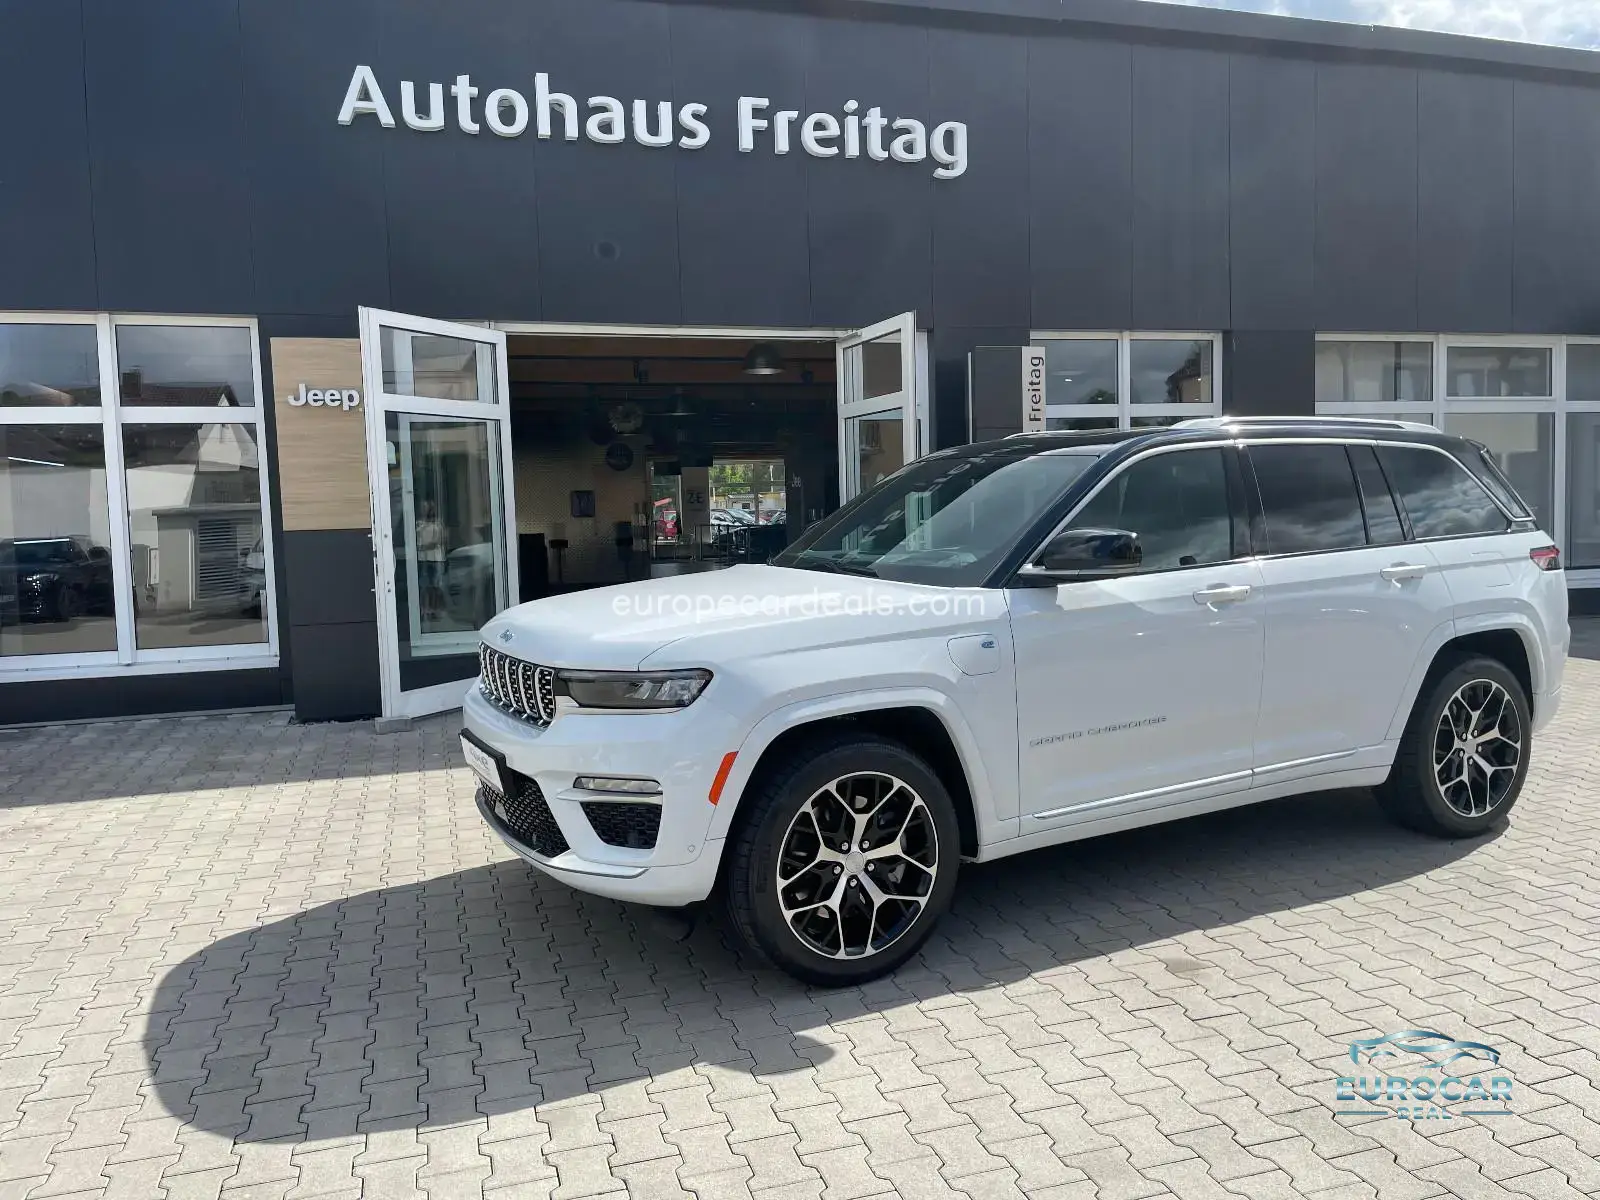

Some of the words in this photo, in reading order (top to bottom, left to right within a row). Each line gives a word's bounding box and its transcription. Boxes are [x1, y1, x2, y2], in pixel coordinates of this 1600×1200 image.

[337, 64, 710, 150] Autohaus
[737, 95, 969, 180] Freitag
[287, 383, 360, 411] Jeep
[1028, 356, 1045, 422] Freitag
